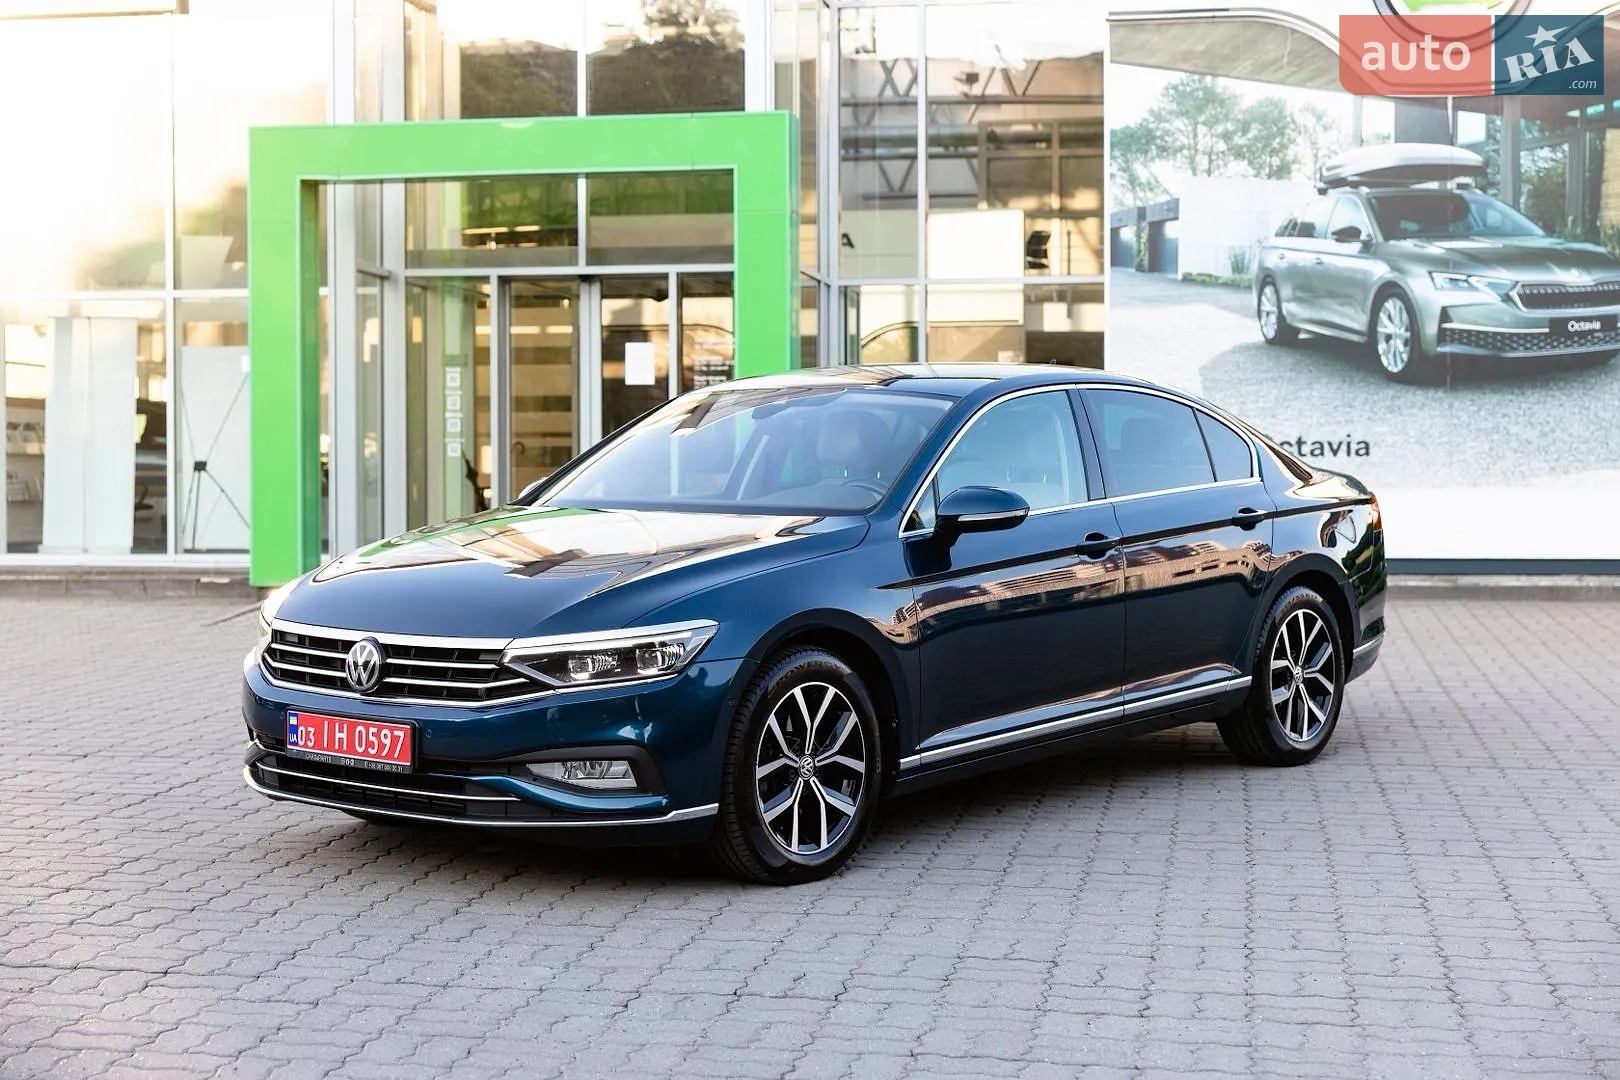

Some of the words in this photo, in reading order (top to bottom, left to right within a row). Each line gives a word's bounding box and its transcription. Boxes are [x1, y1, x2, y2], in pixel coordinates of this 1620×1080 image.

[1568, 320, 1601, 332] Octavia
[1266, 434, 1370, 457] ctavia
[298, 726, 315, 748] 03
[355, 725, 405, 759] 0597
